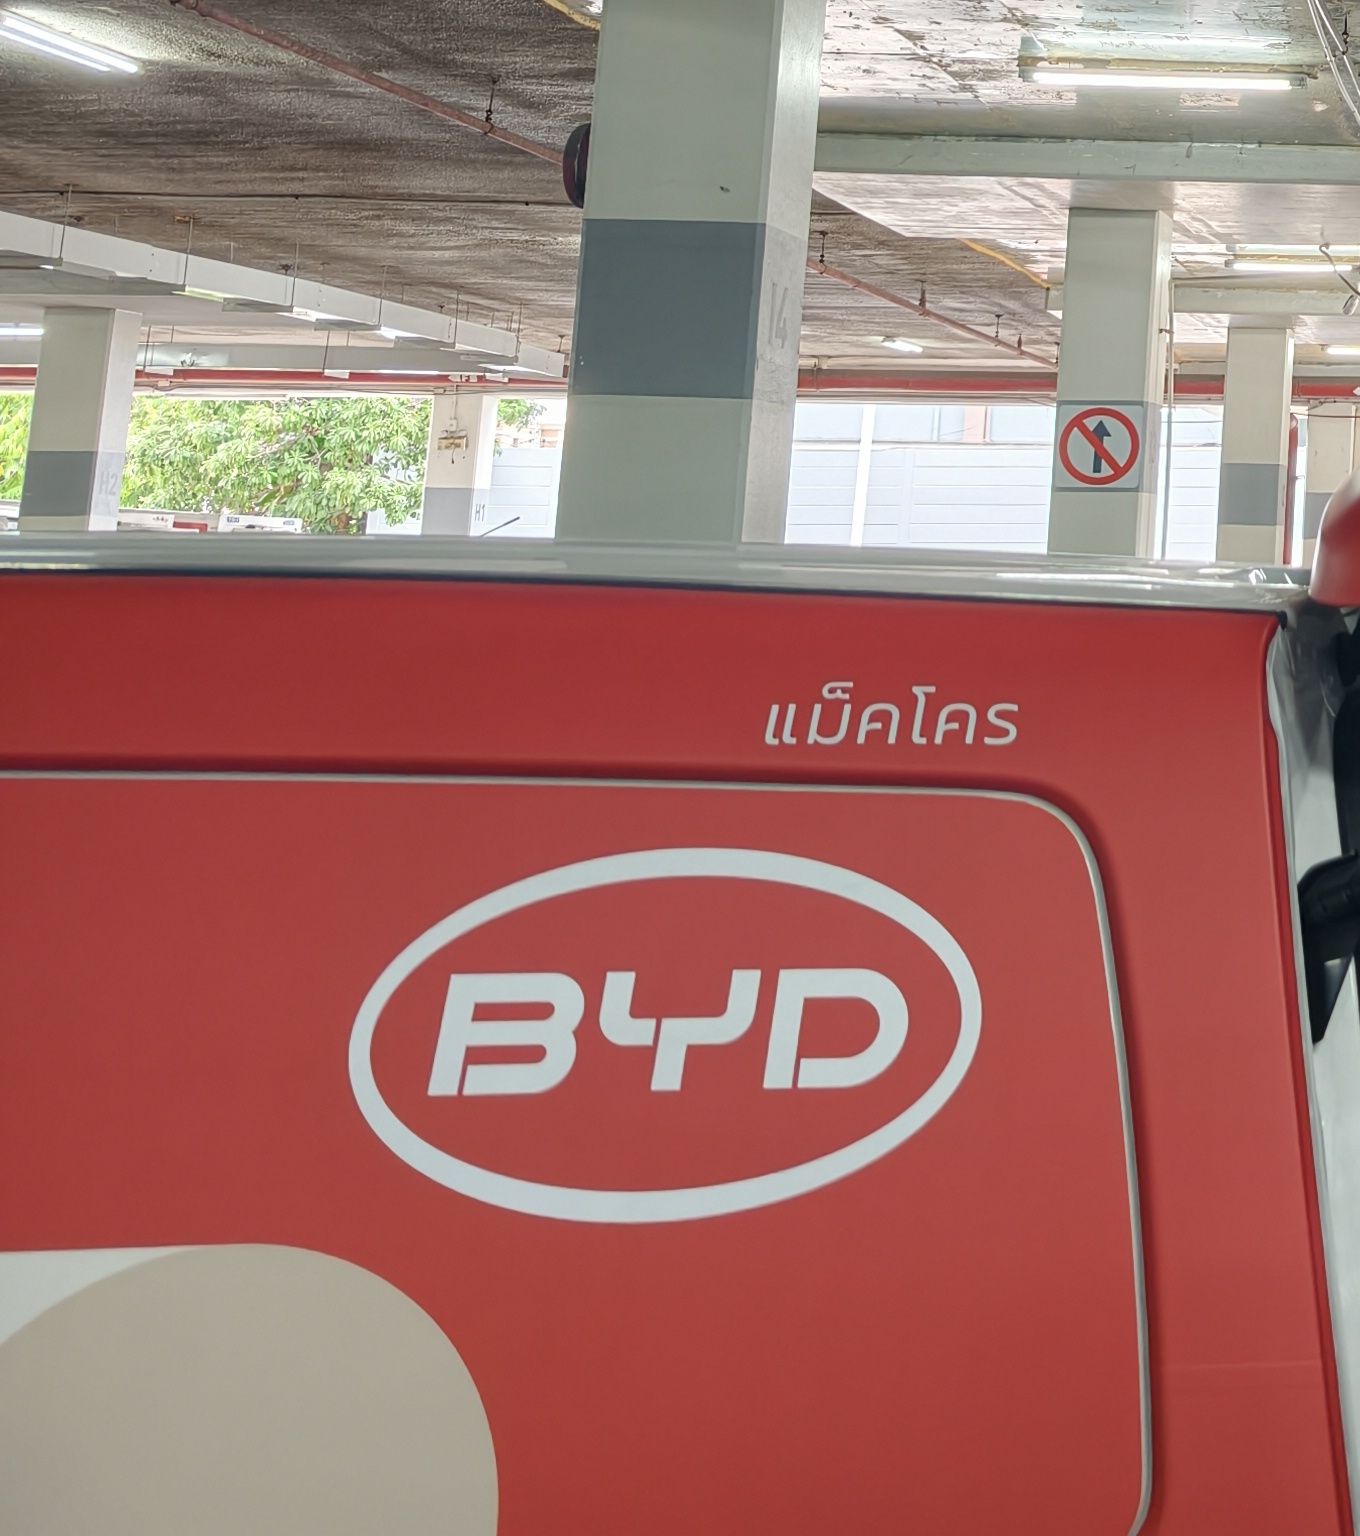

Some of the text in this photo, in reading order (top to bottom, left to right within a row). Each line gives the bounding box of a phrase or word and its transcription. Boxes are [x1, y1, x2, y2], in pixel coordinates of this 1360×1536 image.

[474, 503, 485, 522] H1
[765, 681, 1019, 745] แม็คโคร
[427, 968, 909, 1097] BYD
